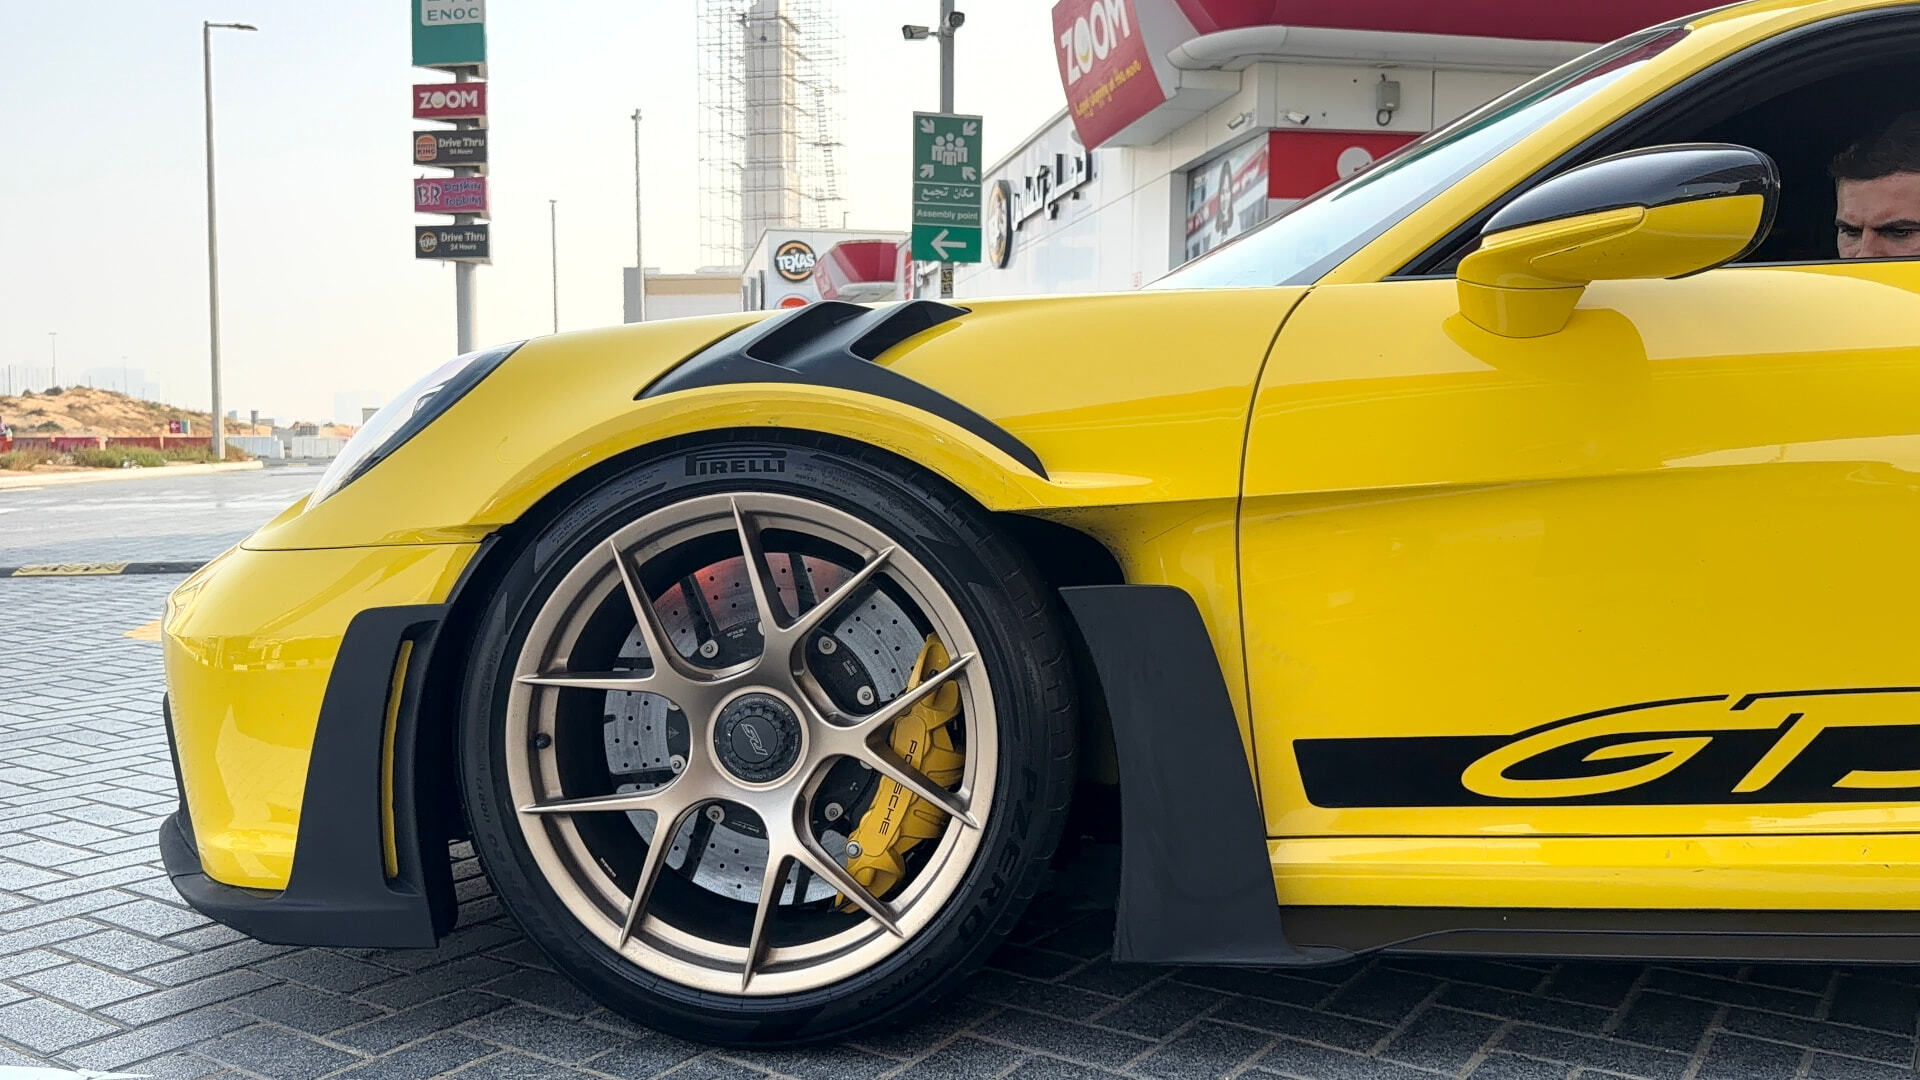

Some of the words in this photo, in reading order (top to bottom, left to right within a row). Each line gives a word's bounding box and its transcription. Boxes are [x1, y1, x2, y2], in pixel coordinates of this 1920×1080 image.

[427, 7, 479, 21] ENOC
[1061, 0, 1130, 86] ZOOM
[419, 90, 478, 109] ZOOM
[439, 137, 461, 147] Drive
[463, 137, 484, 147] Thru
[417, 183, 441, 205] BR
[921, 186, 950, 201] تجمع
[953, 187, 974, 200] مكان
[916, 209, 956, 220] Assembly
[956, 211, 978, 221] point
[441, 232, 463, 242] Drive
[464, 231, 485, 242] Thru
[776, 252, 815, 272] TEXAS
[685, 451, 787, 476] PIRELLI
